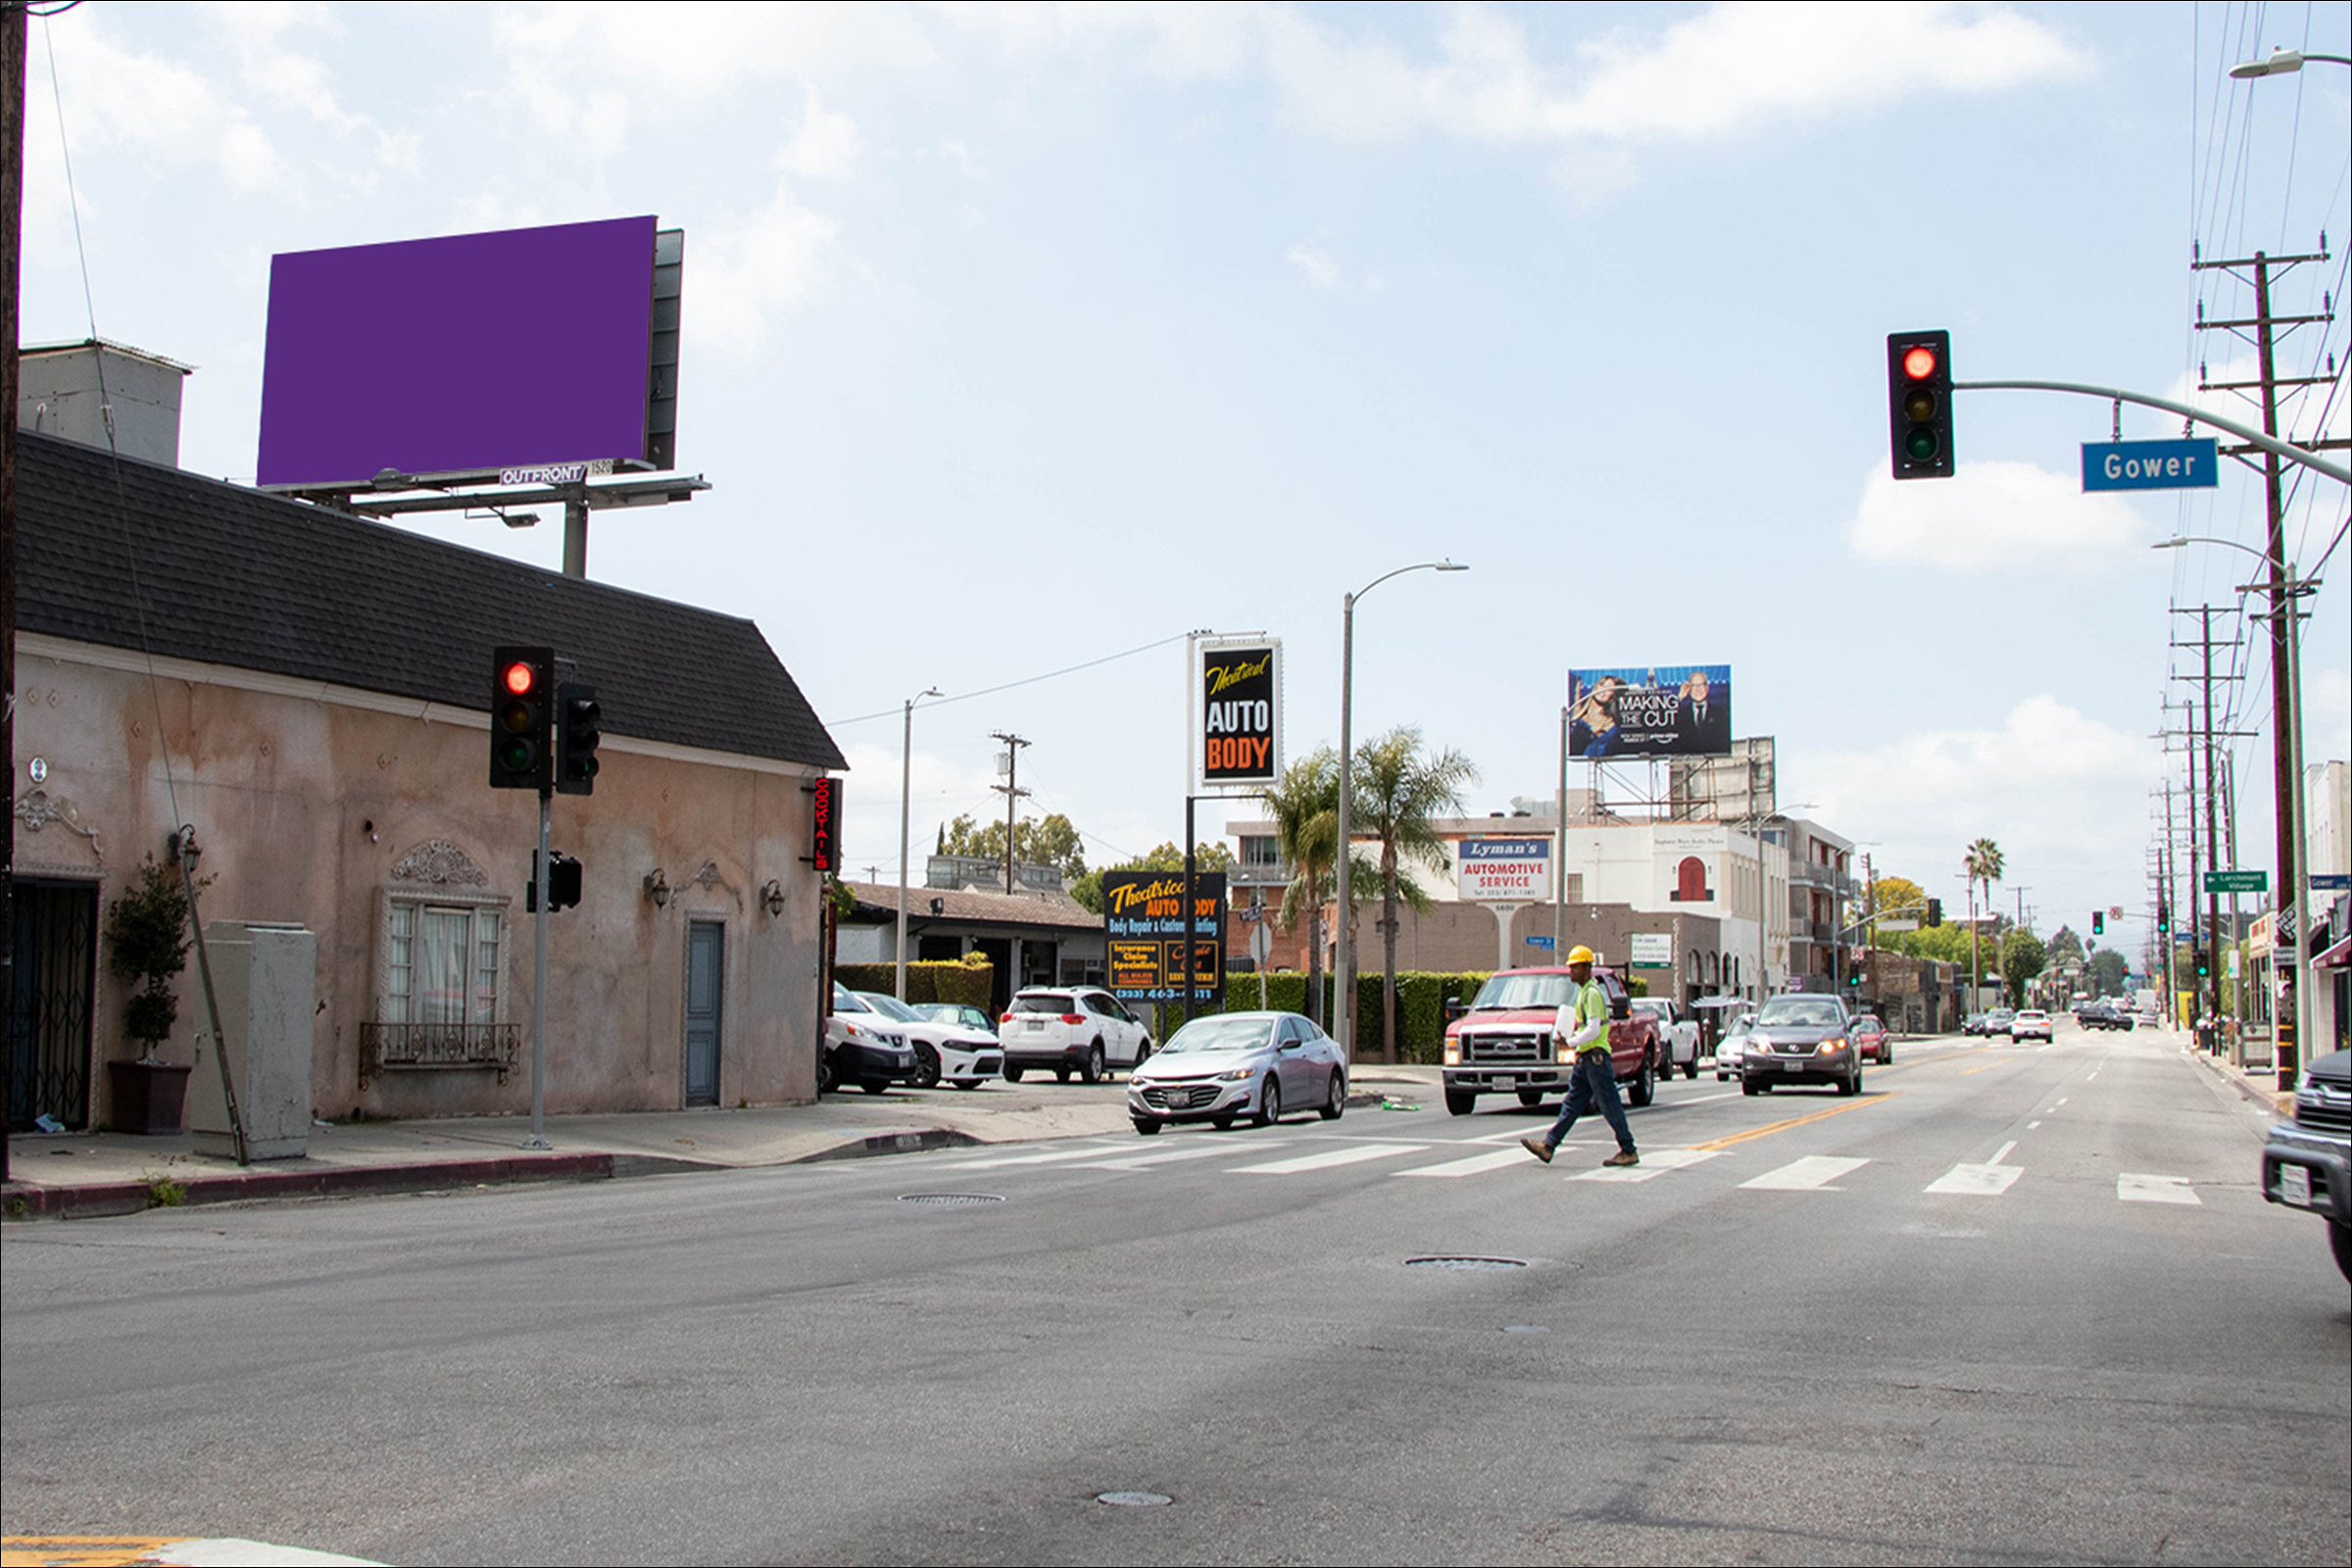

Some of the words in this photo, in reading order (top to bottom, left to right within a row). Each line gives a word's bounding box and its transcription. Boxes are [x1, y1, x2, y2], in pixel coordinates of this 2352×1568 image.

[2103, 453, 2195, 479] Gower
[503, 465, 582, 484] OUTFRONT
[1205, 654, 1271, 695] Theatrical
[1619, 694, 1680, 710] MAKING
[1206, 700, 1269, 733] AUTO
[1621, 713, 1641, 725] THE
[1643, 710, 1678, 727] CUT
[1207, 737, 1271, 769] BODY
[814, 778, 829, 869] COCKTAILS
[1471, 842, 1538, 857] Lyman's
[1464, 863, 1544, 875] AUTOMOTIVE
[1479, 876, 1530, 888] SERVICE
[2228, 882, 2254, 891] Village
[1146, 899, 1180, 916] AUTO
[1183, 899, 1216, 916] ODY
[1109, 917, 1127, 937] Body
[1129, 917, 1152, 937] Repair
[1195, 916, 1217, 937] inting
[1114, 944, 1156, 953] Insurance
[1123, 952, 1148, 960] Claim
[1113, 959, 1158, 971] Specialists
[1115, 988, 1145, 1000] (323)
[1148, 988, 1211, 1000] 463-11
